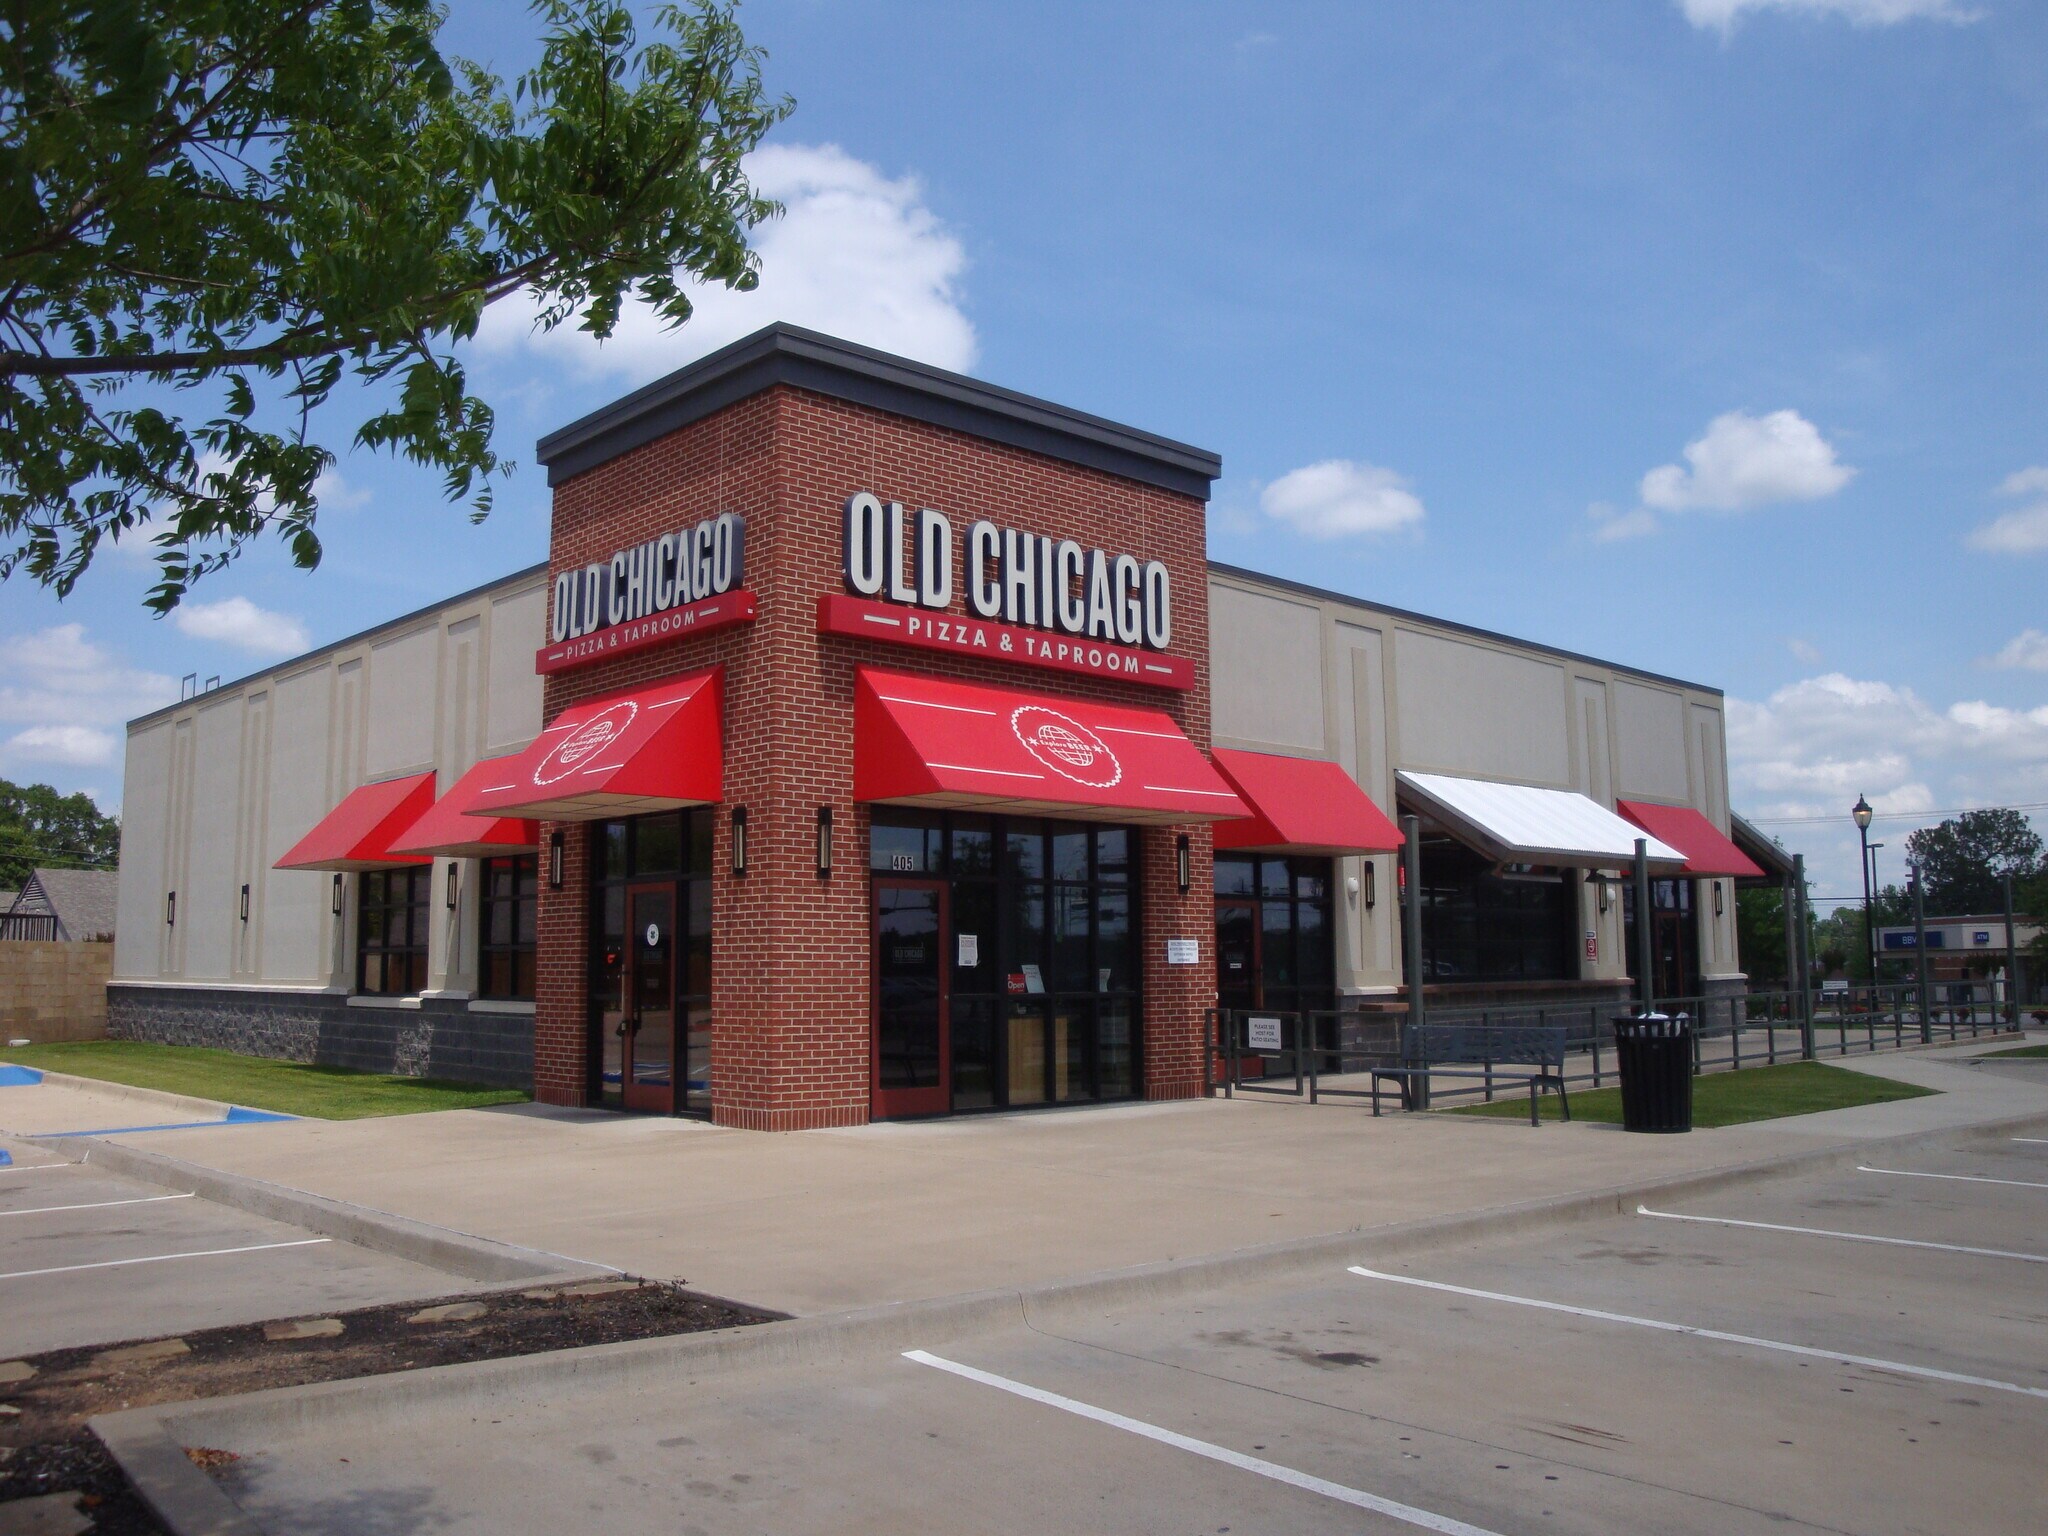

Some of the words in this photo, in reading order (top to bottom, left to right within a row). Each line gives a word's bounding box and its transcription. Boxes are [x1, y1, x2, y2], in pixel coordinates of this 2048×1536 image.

[552, 563, 601, 643] OLD
[608, 512, 734, 626] CHICAGO
[850, 491, 952, 608] OLD
[971, 520, 1171, 649] CHICAGO
[566, 637, 605, 660] PIZZA
[609, 633, 618, 647] &
[624, 610, 695, 643] TAPROOM
[908, 617, 987, 648] PIZZA
[1000, 633, 1014, 653] &
[1026, 637, 1140, 674] TAPROOM
[893, 856, 913, 870] 405
[1902, 936, 1917, 945] BBV
[1007, 980, 1025, 990] Open
